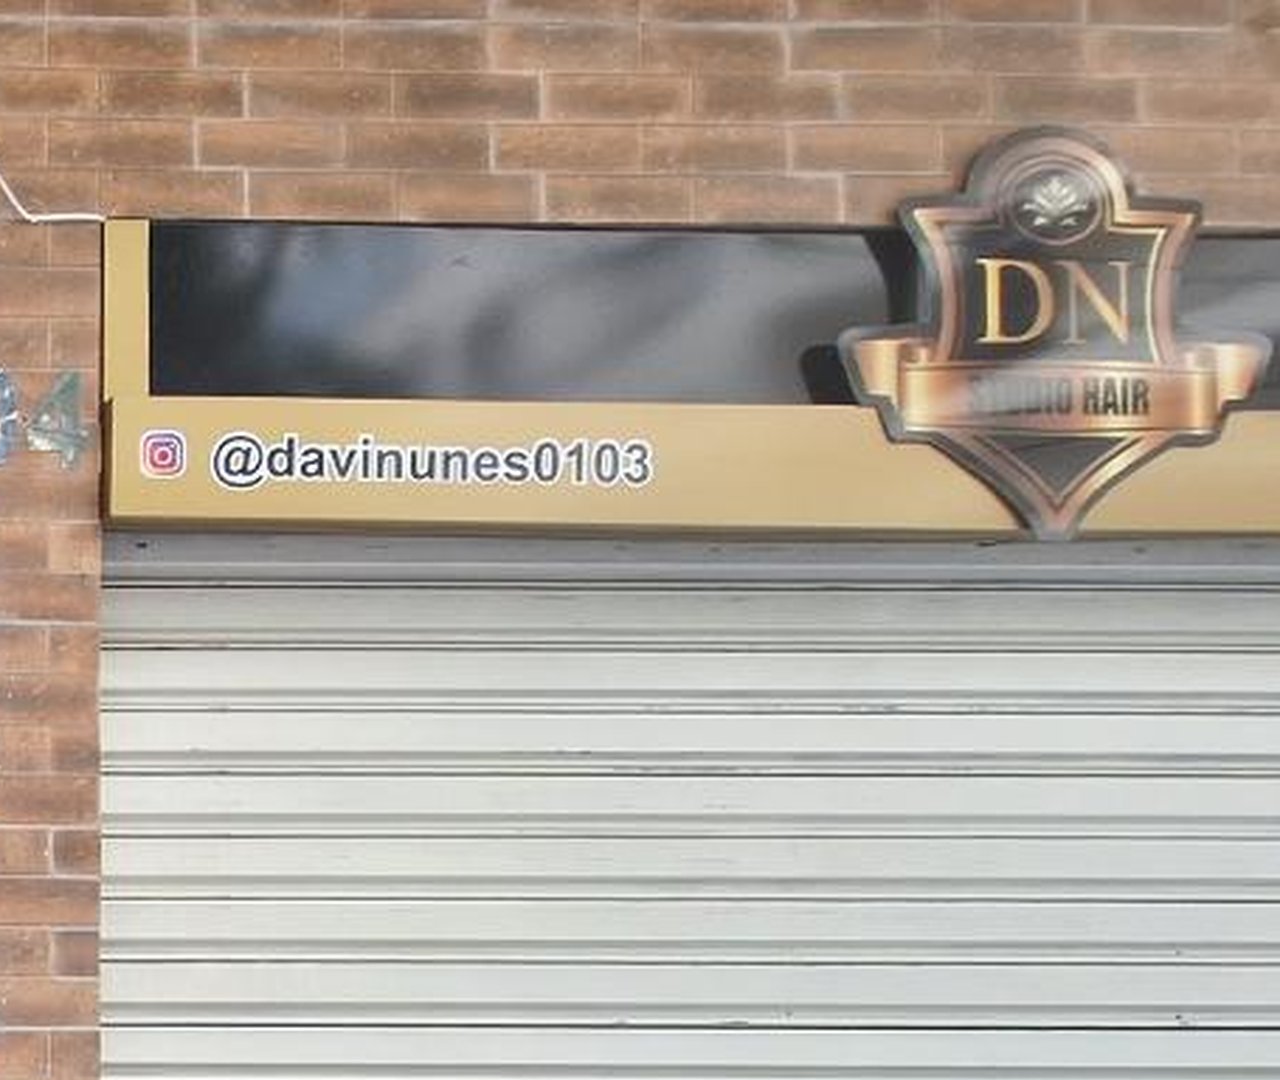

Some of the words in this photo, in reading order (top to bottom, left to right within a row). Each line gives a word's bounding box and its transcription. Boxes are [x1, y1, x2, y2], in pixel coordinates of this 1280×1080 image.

[976, 256, 1133, 345] DN
[1081, 376, 1150, 416] HAIR
[212, 433, 652, 489] @davinunes0103
